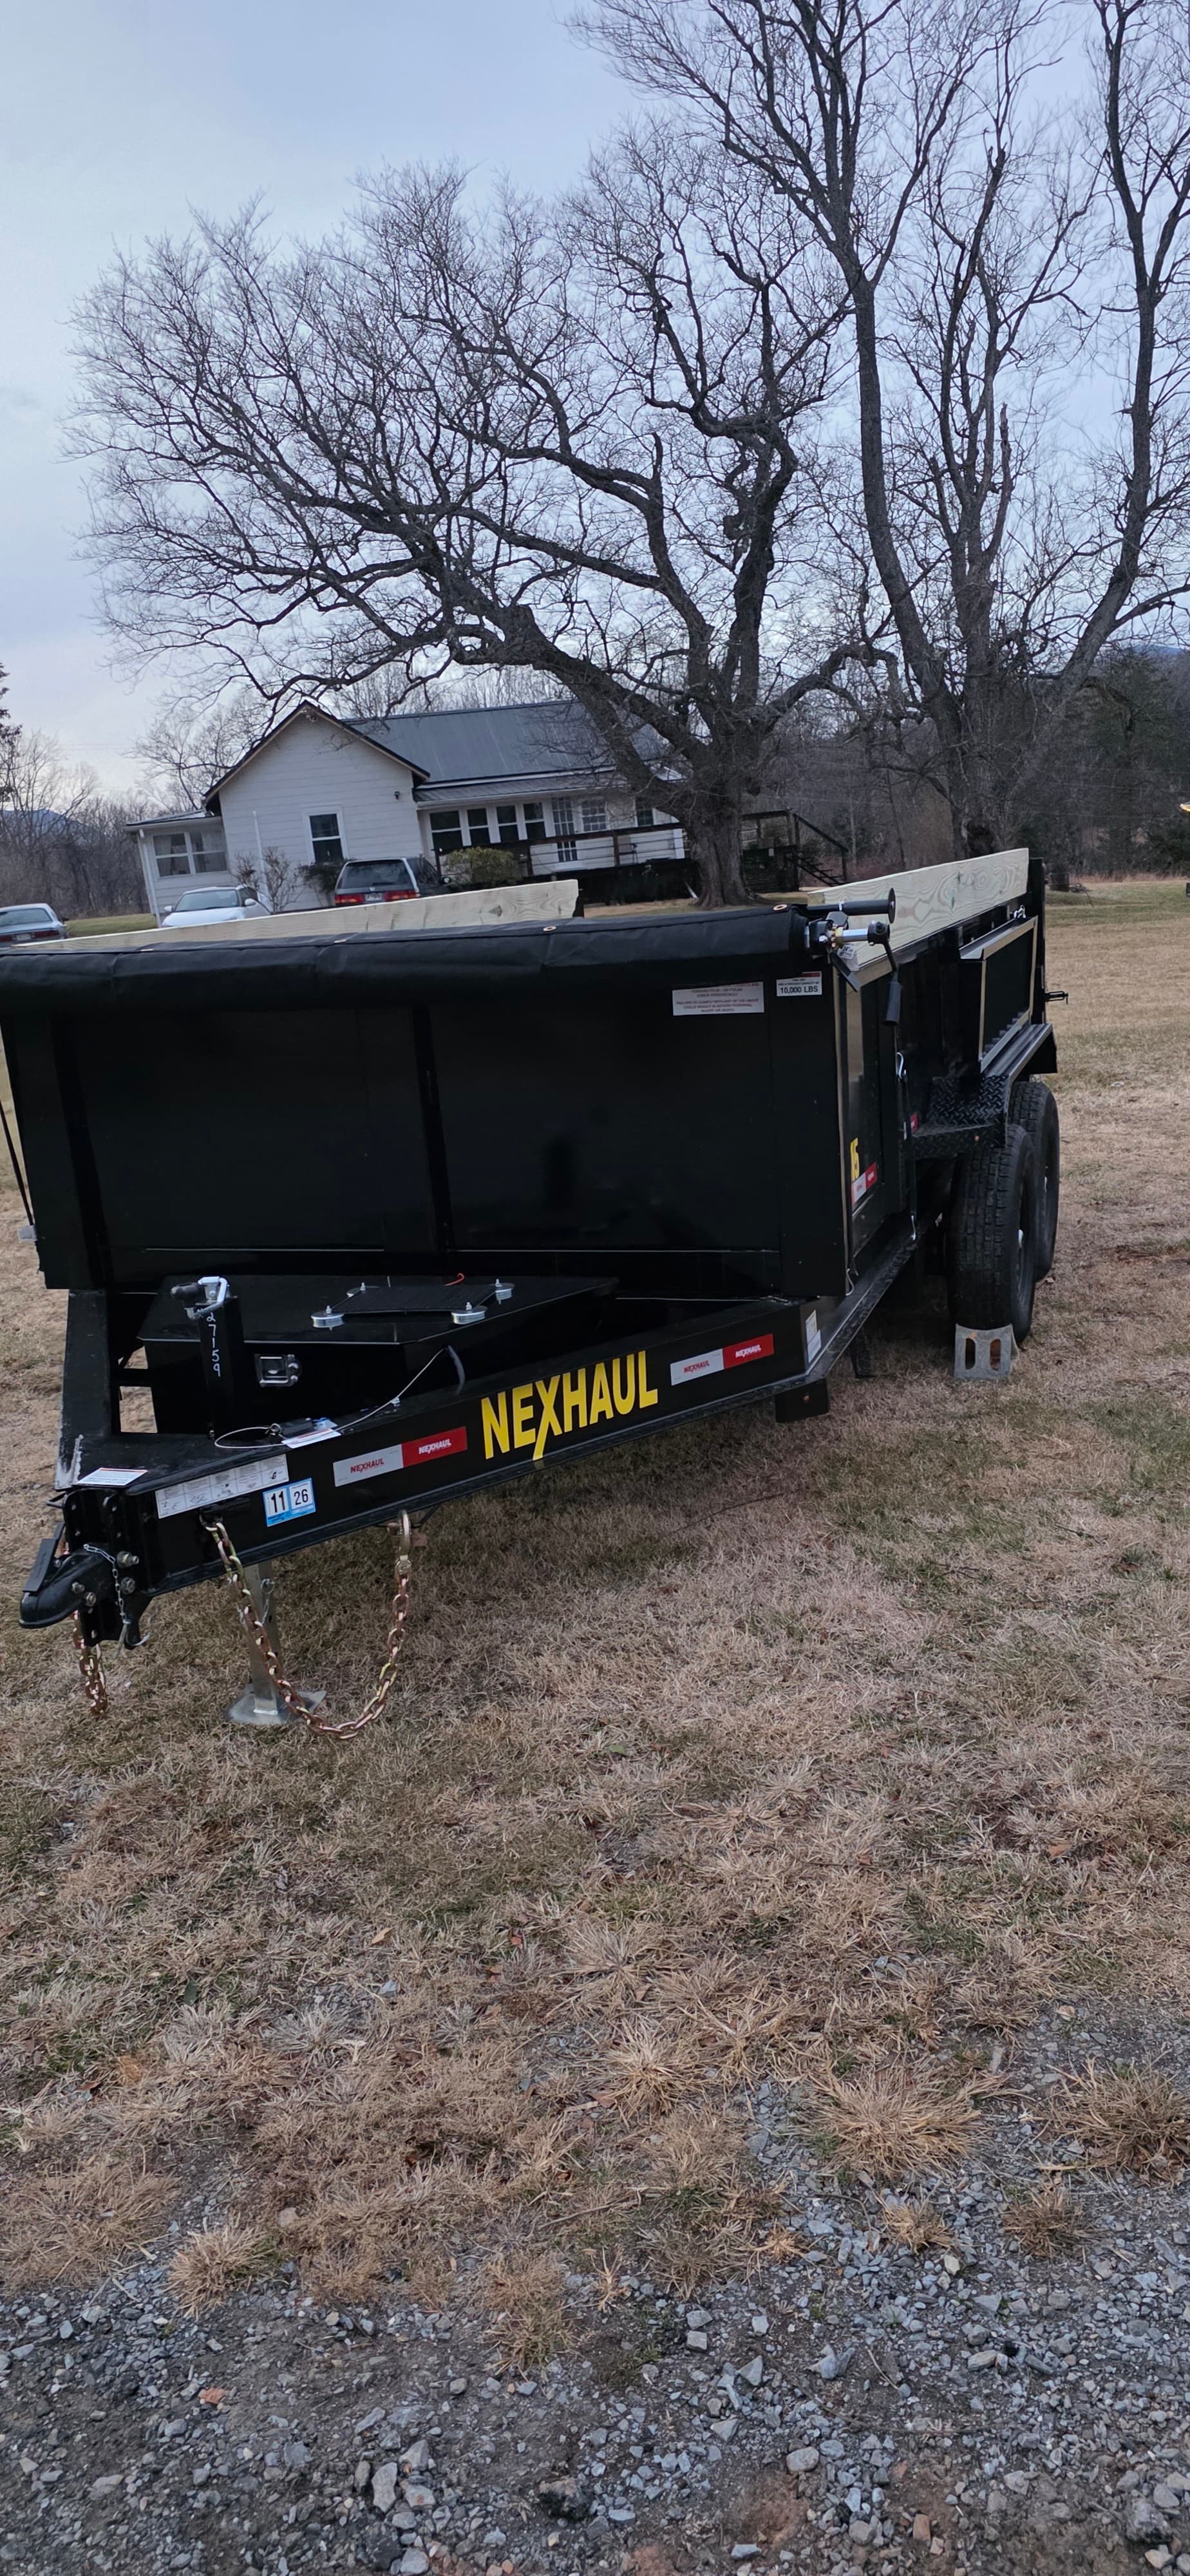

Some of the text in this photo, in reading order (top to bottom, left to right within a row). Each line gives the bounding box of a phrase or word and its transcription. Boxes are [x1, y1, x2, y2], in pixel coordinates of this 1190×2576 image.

[206, 1312, 221, 1377] 27159
[735, 1345, 762, 1358] NEXHAUL
[683, 1360, 710, 1373] NEXHAUL
[481, 1350, 658, 1461] NEXHAUL
[419, 1439, 452, 1455] NEXHAUL
[350, 1458, 385, 1473] NEXHAUL
[271, 1489, 308, 1513] 11 26
